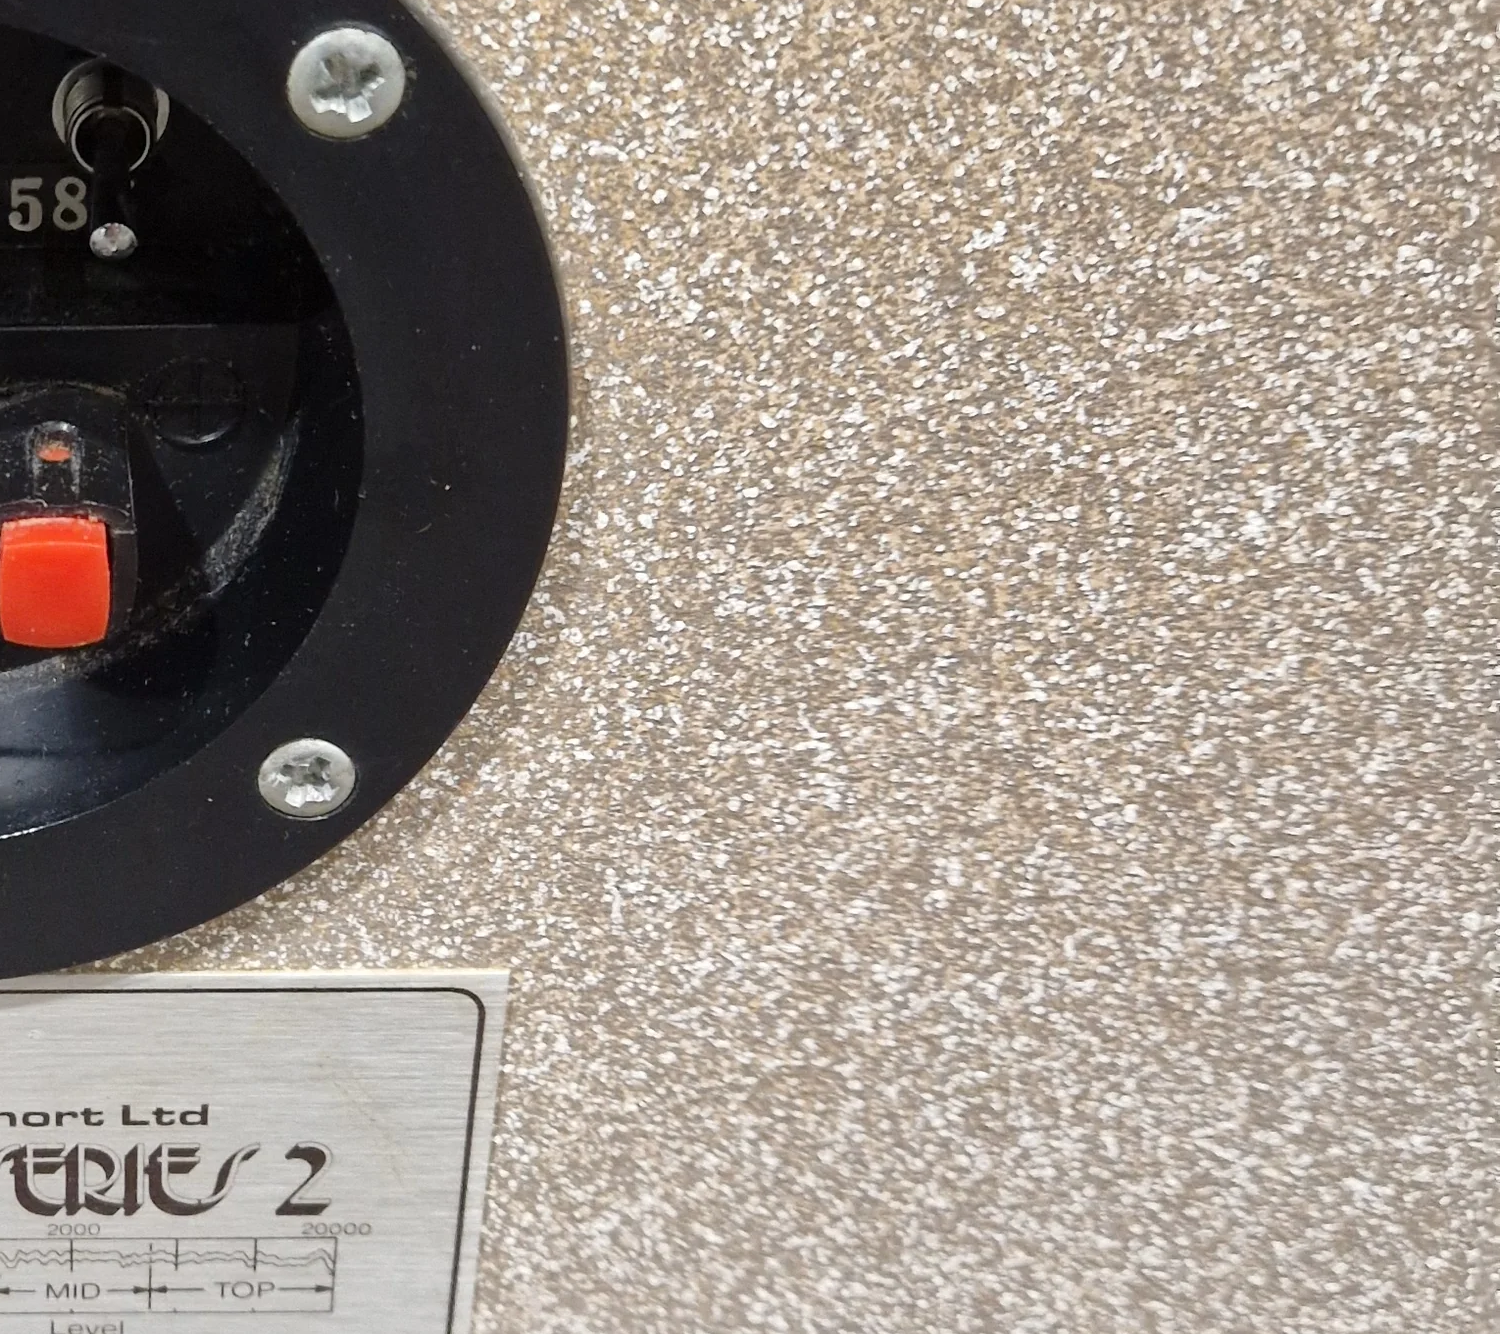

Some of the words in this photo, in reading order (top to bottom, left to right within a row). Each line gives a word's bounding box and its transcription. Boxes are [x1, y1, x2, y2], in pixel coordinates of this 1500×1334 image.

[121, 1103, 209, 1127] Ltd
[275, 1140, 334, 1216] 2
[47, 1222, 101, 1237] 2000
[302, 1222, 372, 1237] 20000
[45, 1282, 101, 1300] MID
[214, 1280, 276, 1299] TOP
